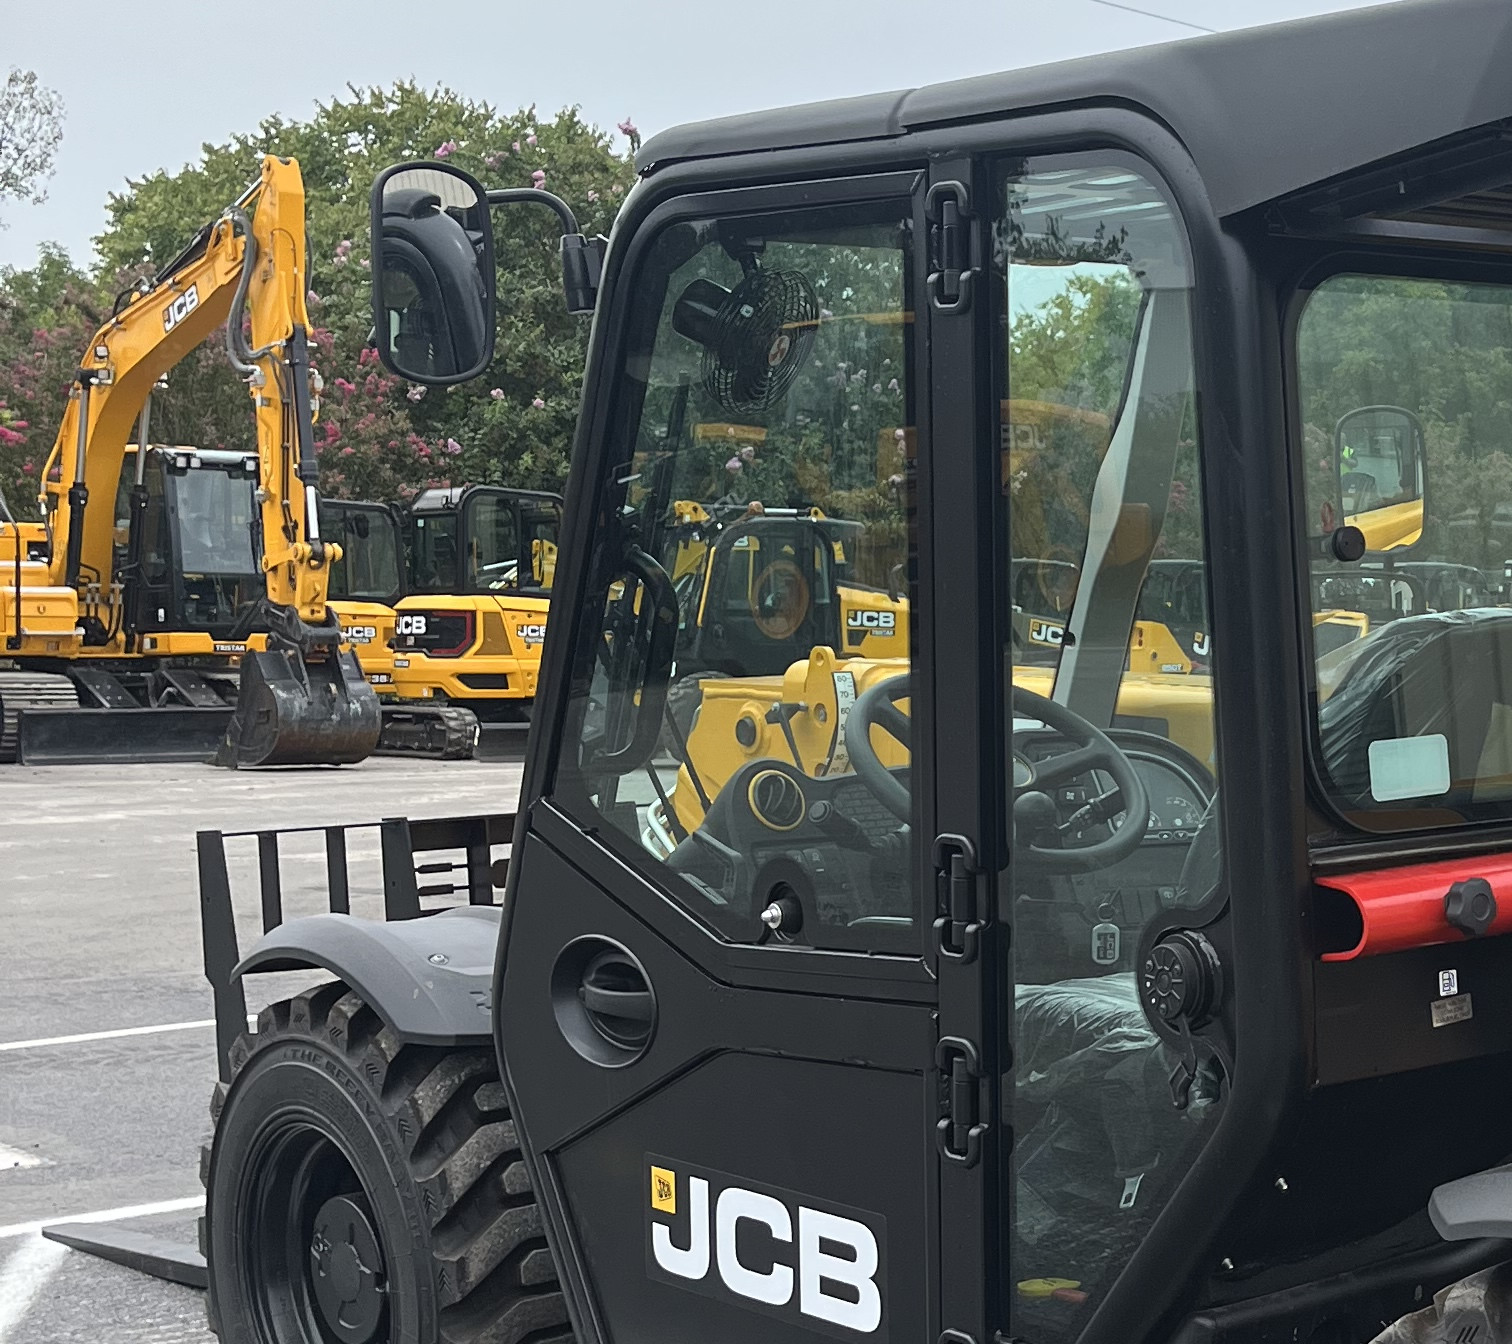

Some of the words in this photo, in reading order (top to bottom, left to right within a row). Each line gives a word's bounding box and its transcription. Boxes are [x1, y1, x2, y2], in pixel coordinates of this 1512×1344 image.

[164, 284, 199, 331] JCB
[396, 616, 427, 634] JCB
[847, 610, 895, 628] JCB
[341, 626, 376, 637] JCB
[290, 1048, 323, 1067] THE
[652, 1175, 882, 1333] JCB
